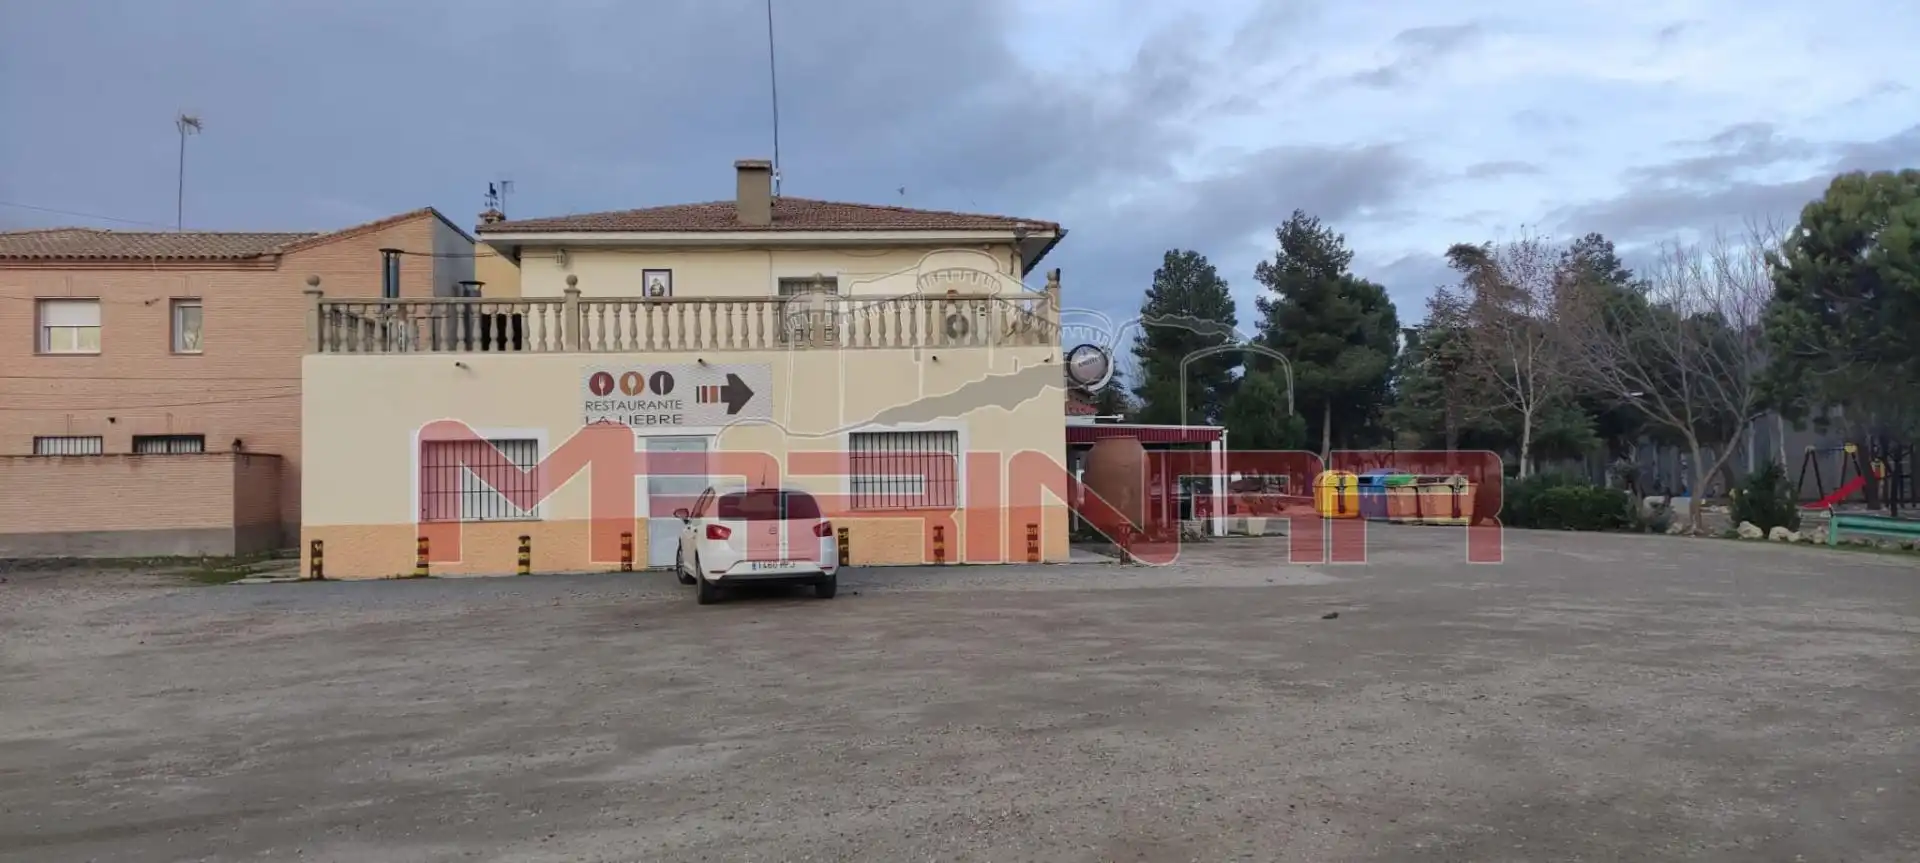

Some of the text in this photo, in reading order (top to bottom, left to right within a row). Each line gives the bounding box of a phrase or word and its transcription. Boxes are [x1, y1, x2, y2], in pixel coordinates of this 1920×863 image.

[585, 400, 683, 412] RESTAURANTE
[585, 413, 684, 426] LA LIEBRE
